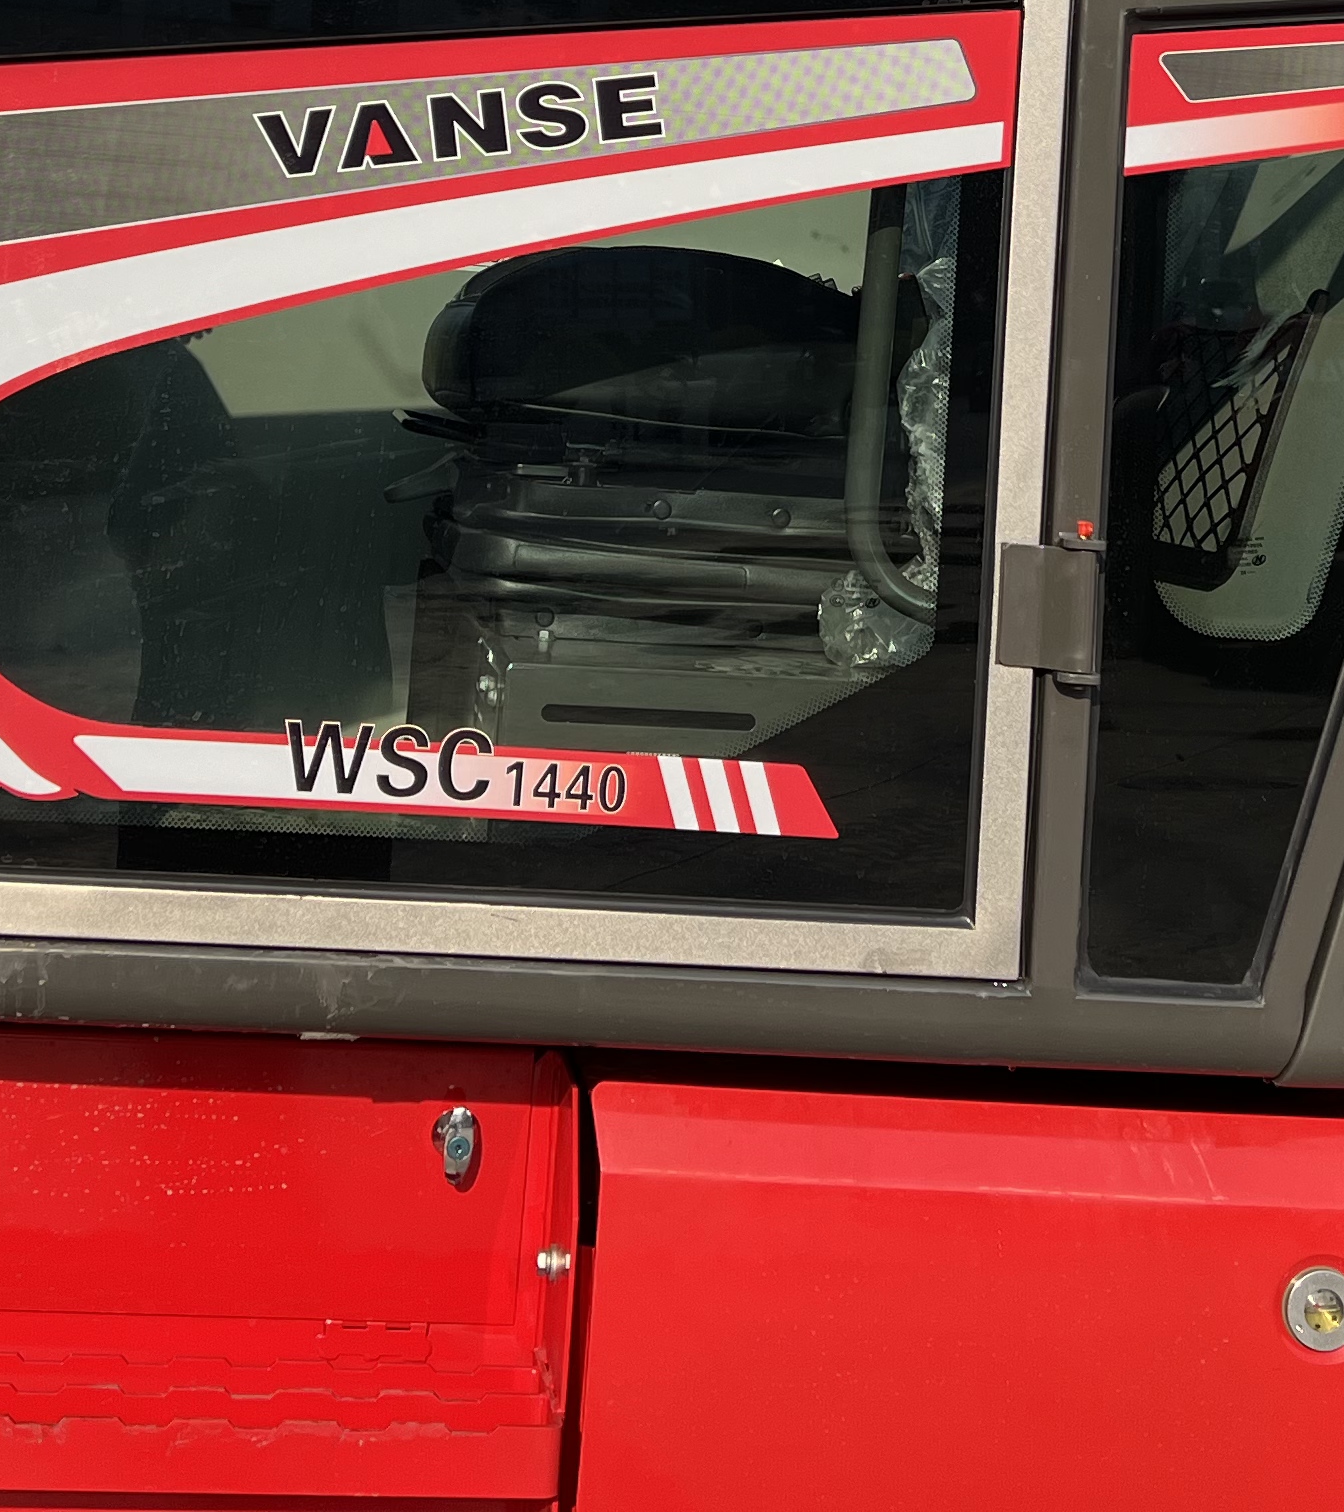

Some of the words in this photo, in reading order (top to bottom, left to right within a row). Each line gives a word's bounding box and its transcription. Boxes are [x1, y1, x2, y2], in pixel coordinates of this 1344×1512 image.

[253, 71, 666, 178] VANSE
[284, 719, 495, 801] WSC
[505, 760, 629, 814] 1440
